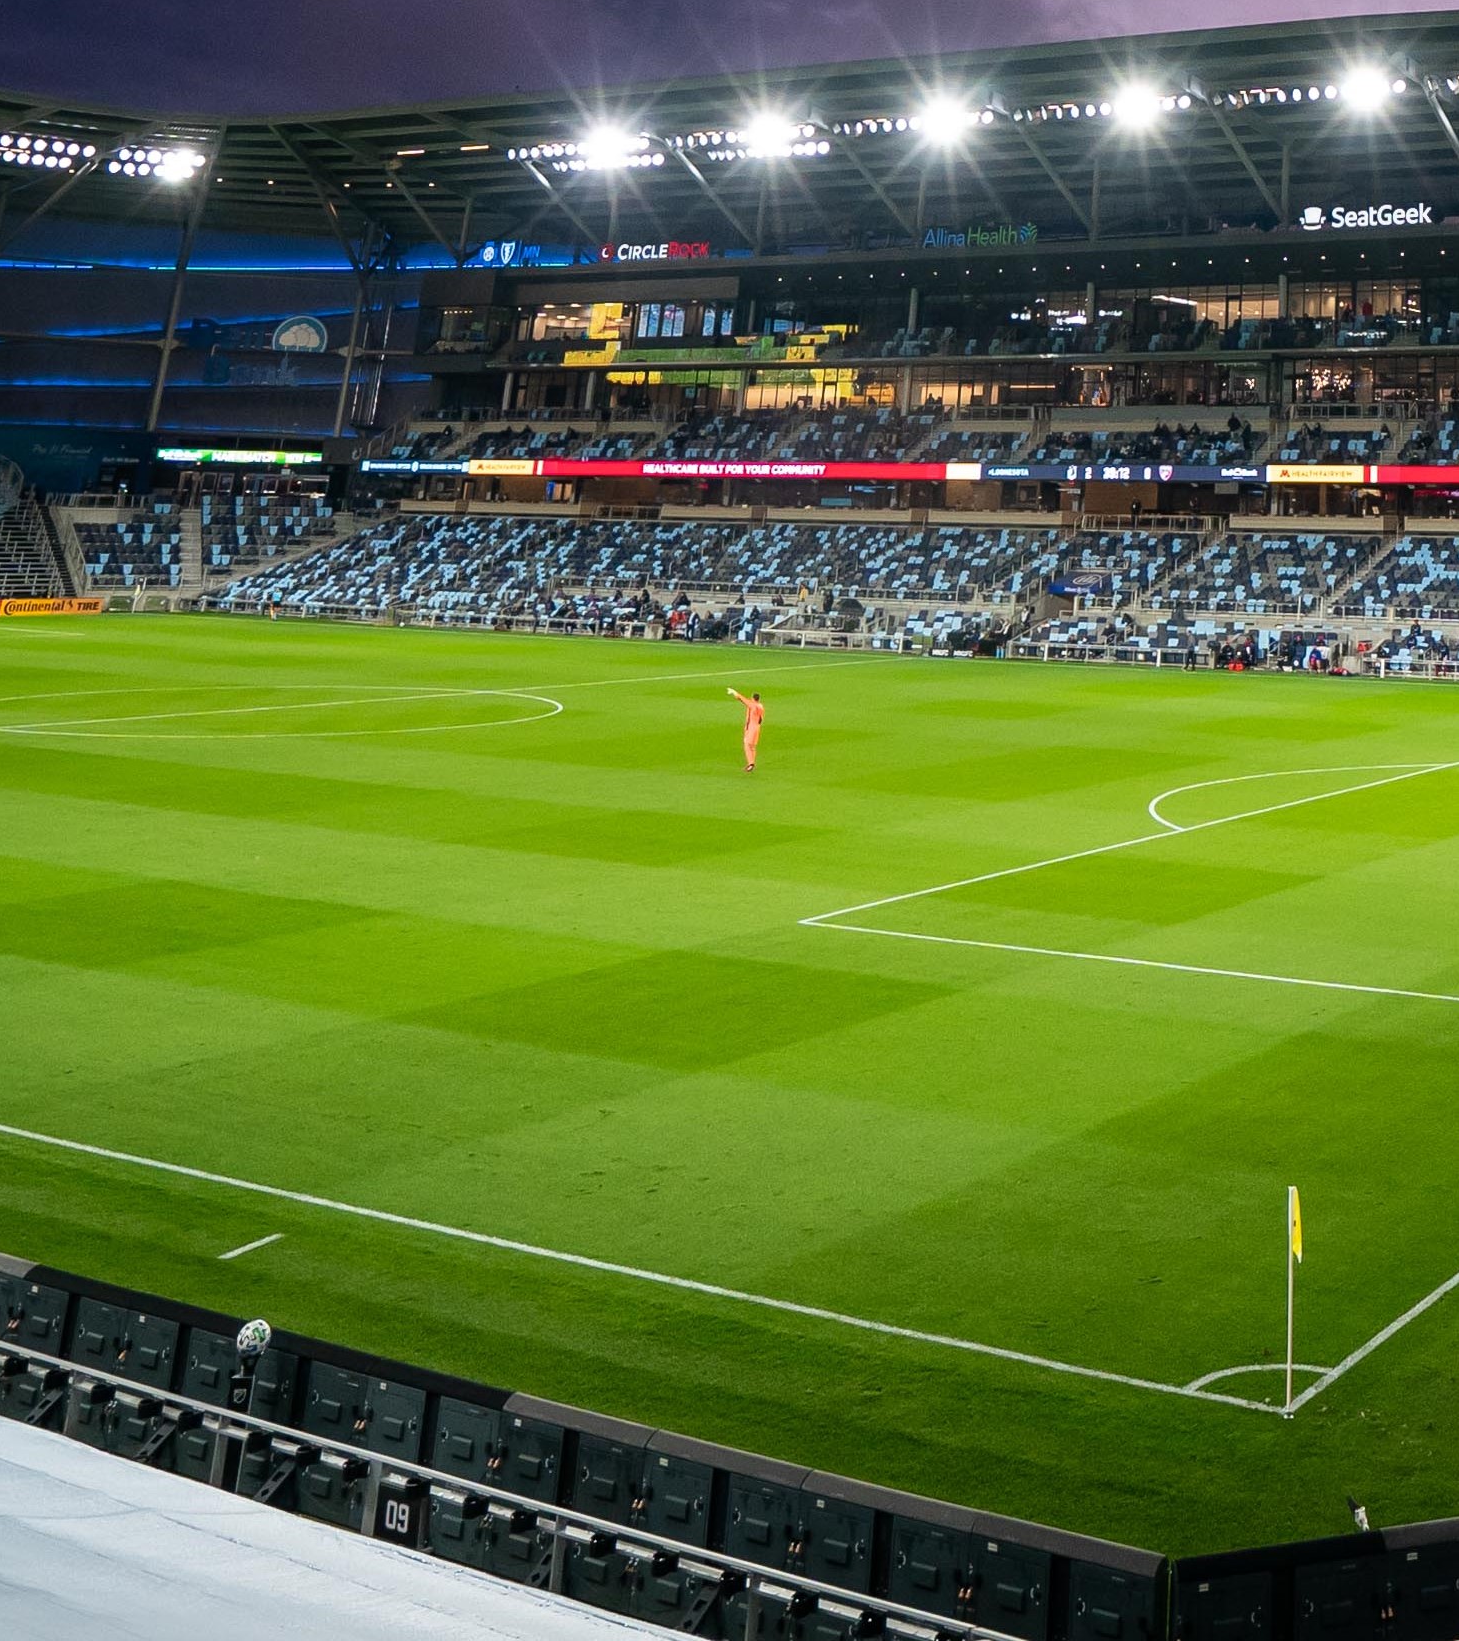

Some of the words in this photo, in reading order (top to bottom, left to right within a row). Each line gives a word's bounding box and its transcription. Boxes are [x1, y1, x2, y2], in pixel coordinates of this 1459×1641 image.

[1331, 203, 1432, 228] SeatGeek
[923, 227, 965, 249] Allina
[966, 225, 1018, 247] Health
[643, 464, 699, 474] HEALTHCARE
[699, 464, 724, 474] BUILT
[725, 464, 744, 474] FOR
[745, 464, 771, 475] YOUR
[771, 464, 826, 475] COMMUNITY
[4, 600, 66, 615] Continental
[76, 601, 100, 611] TIRE
[385, 1500, 410, 1534] 09
